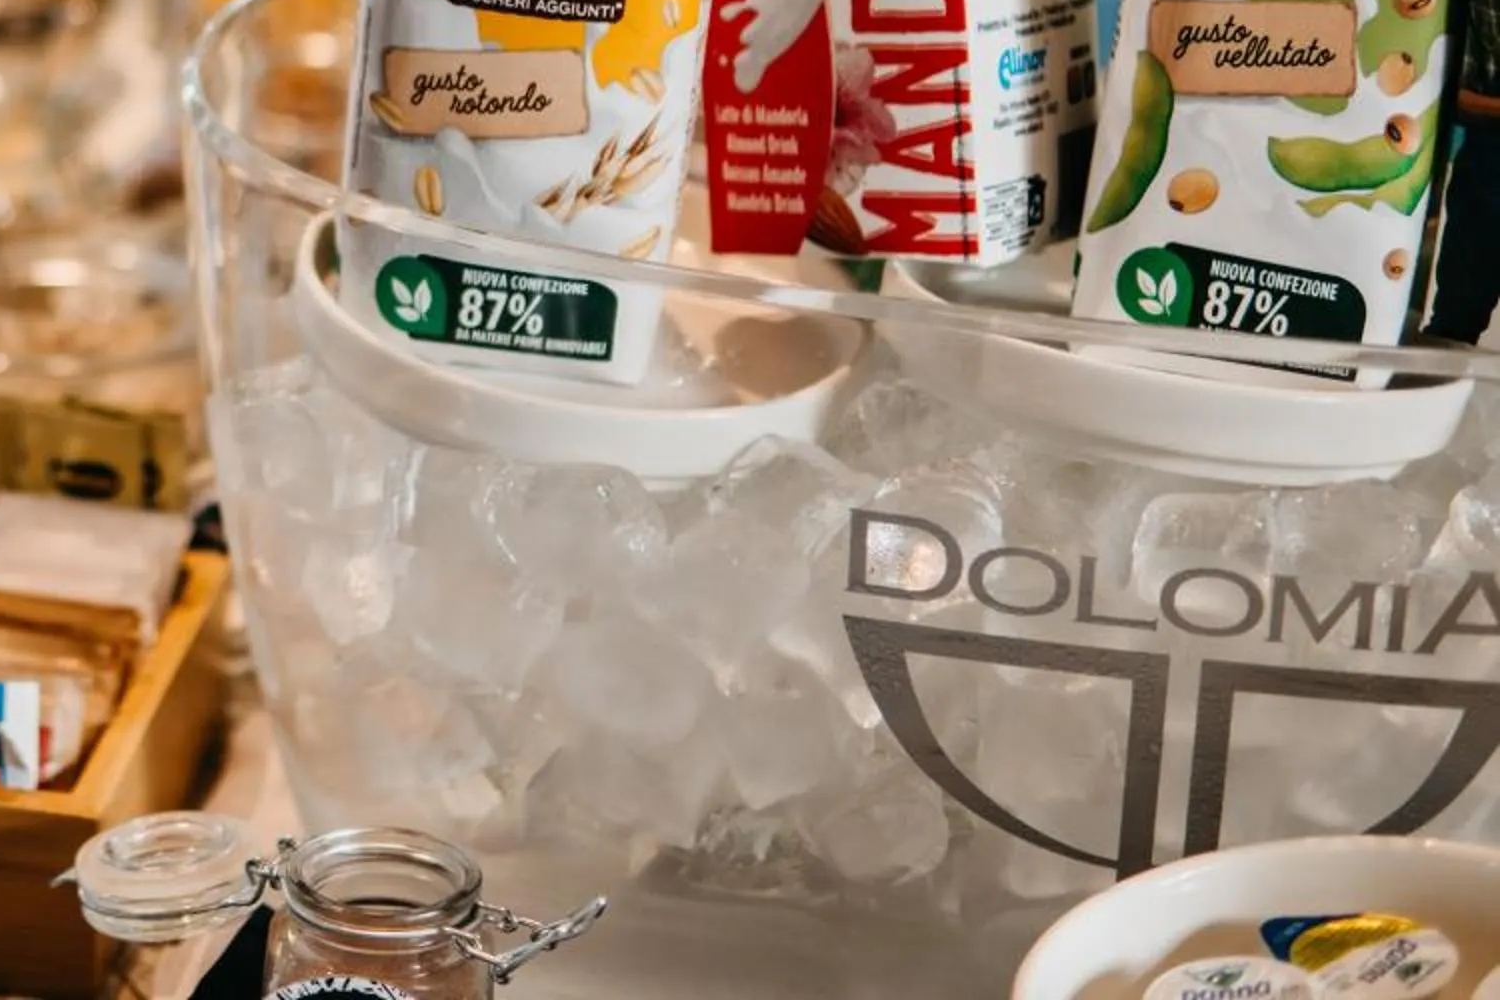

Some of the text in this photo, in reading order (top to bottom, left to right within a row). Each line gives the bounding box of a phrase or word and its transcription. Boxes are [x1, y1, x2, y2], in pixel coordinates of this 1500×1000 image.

[1173, 14, 1251, 59] gusto
[1214, 35, 1336, 68] vellutato
[410, 64, 484, 106] gusto
[999, 46, 1047, 90] Alinor
[449, 81, 553, 115] rotondo
[462, 268, 589, 296] NUOVA CONFEZIONE
[1210, 259, 1339, 301] NUOVA CONFEZIONE
[458, 287, 544, 336] 87%
[1203, 280, 1289, 336] 87%
[844, 508, 1500, 656] DOLOMIA
